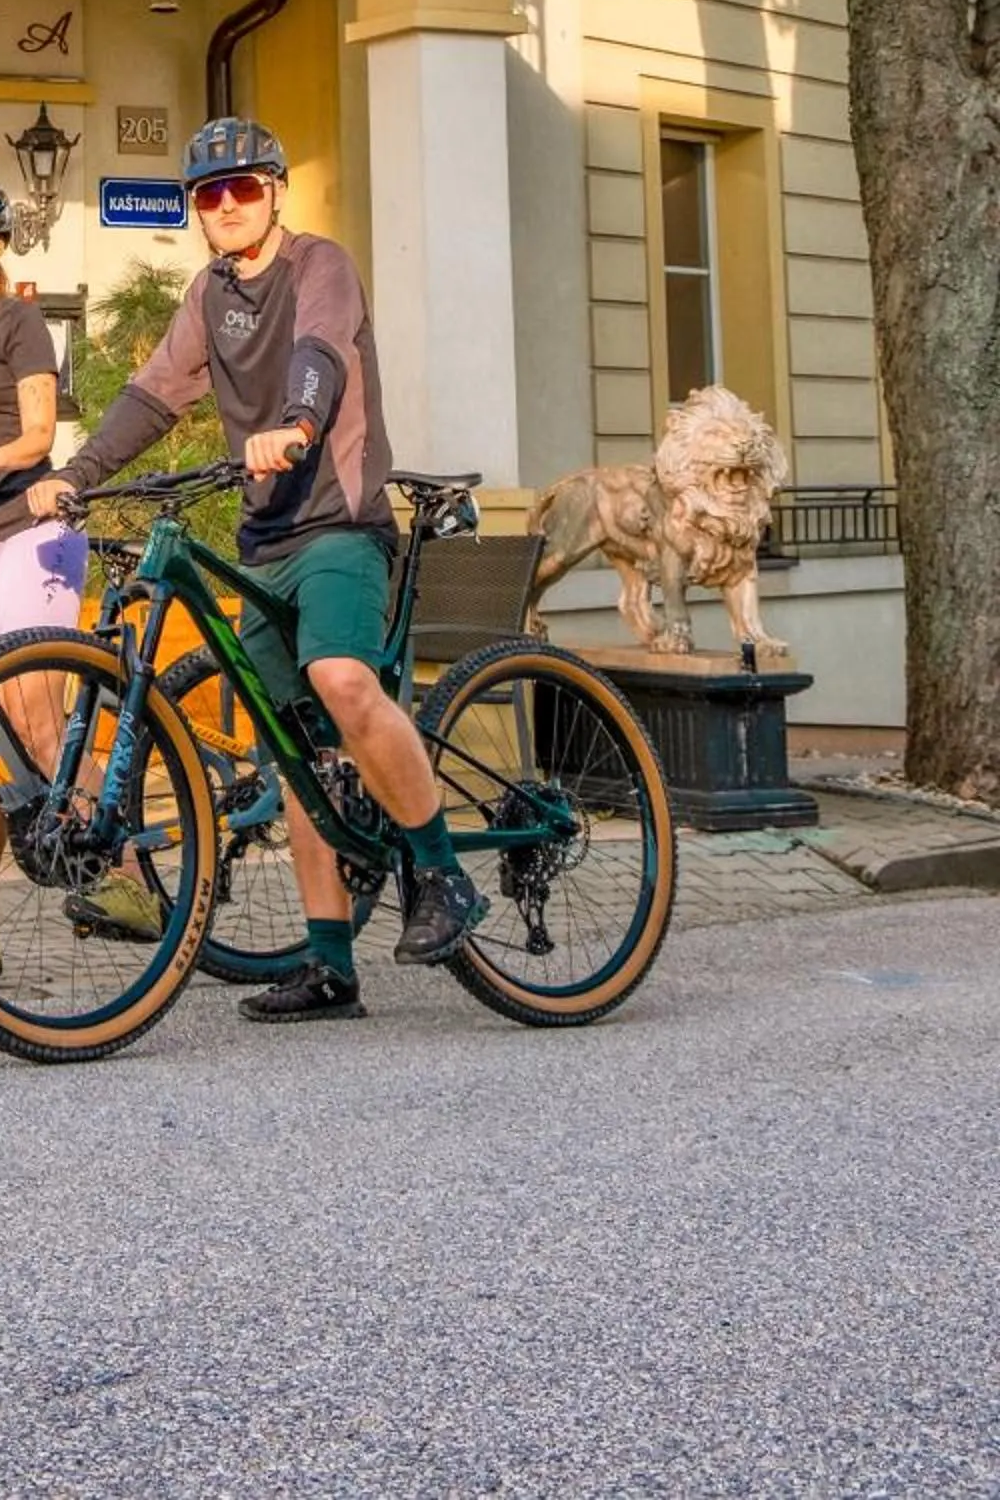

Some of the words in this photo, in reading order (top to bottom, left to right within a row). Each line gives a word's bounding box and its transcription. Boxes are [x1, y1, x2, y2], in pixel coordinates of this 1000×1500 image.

[120, 116, 168, 145] 205
[108, 192, 182, 214] KAŠTANOVÁ
[174, 877, 211, 971] MAXXIS
